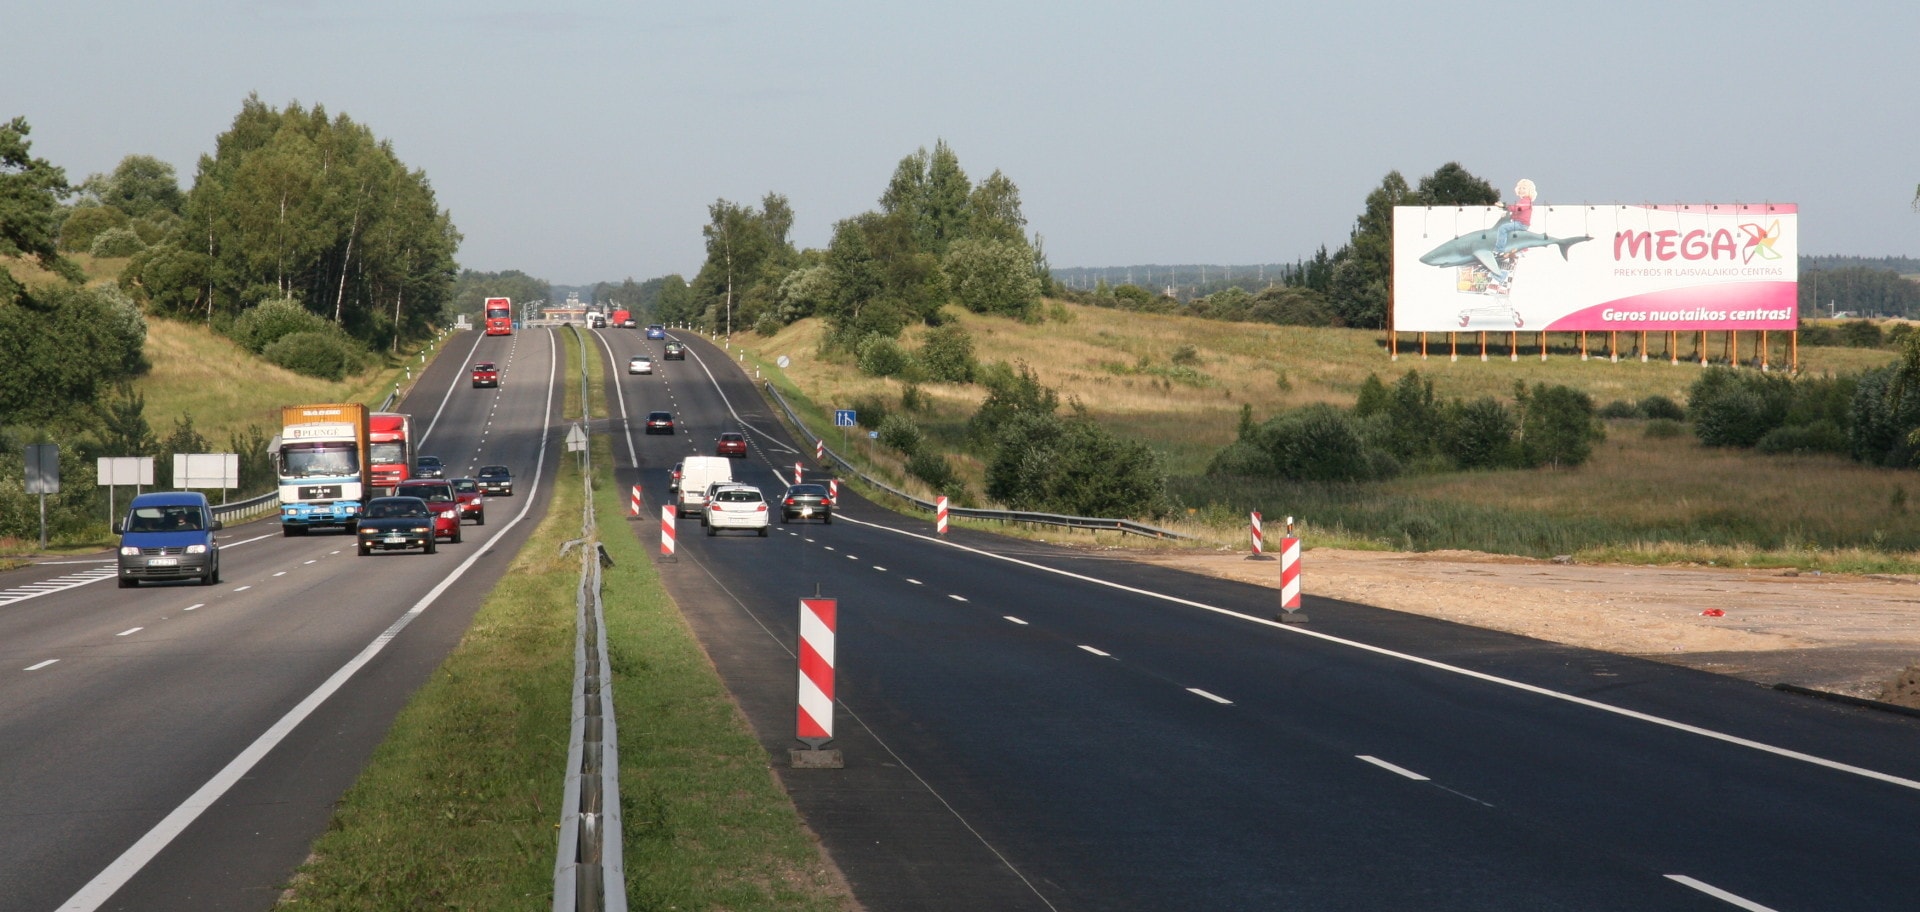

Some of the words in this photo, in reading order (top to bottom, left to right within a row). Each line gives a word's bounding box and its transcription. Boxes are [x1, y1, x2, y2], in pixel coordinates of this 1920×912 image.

[1613, 228, 1737, 261] MEGA
[1613, 268, 1661, 277] PREKYBOS
[1664, 268, 1673, 276] IR
[1676, 267, 1738, 276] LAISVALAIKIO
[1740, 267, 1783, 276] CENTRAS
[1602, 308, 1647, 322] Geros
[1649, 307, 1727, 321] nuotaikos
[1729, 306, 1792, 321] centras!
